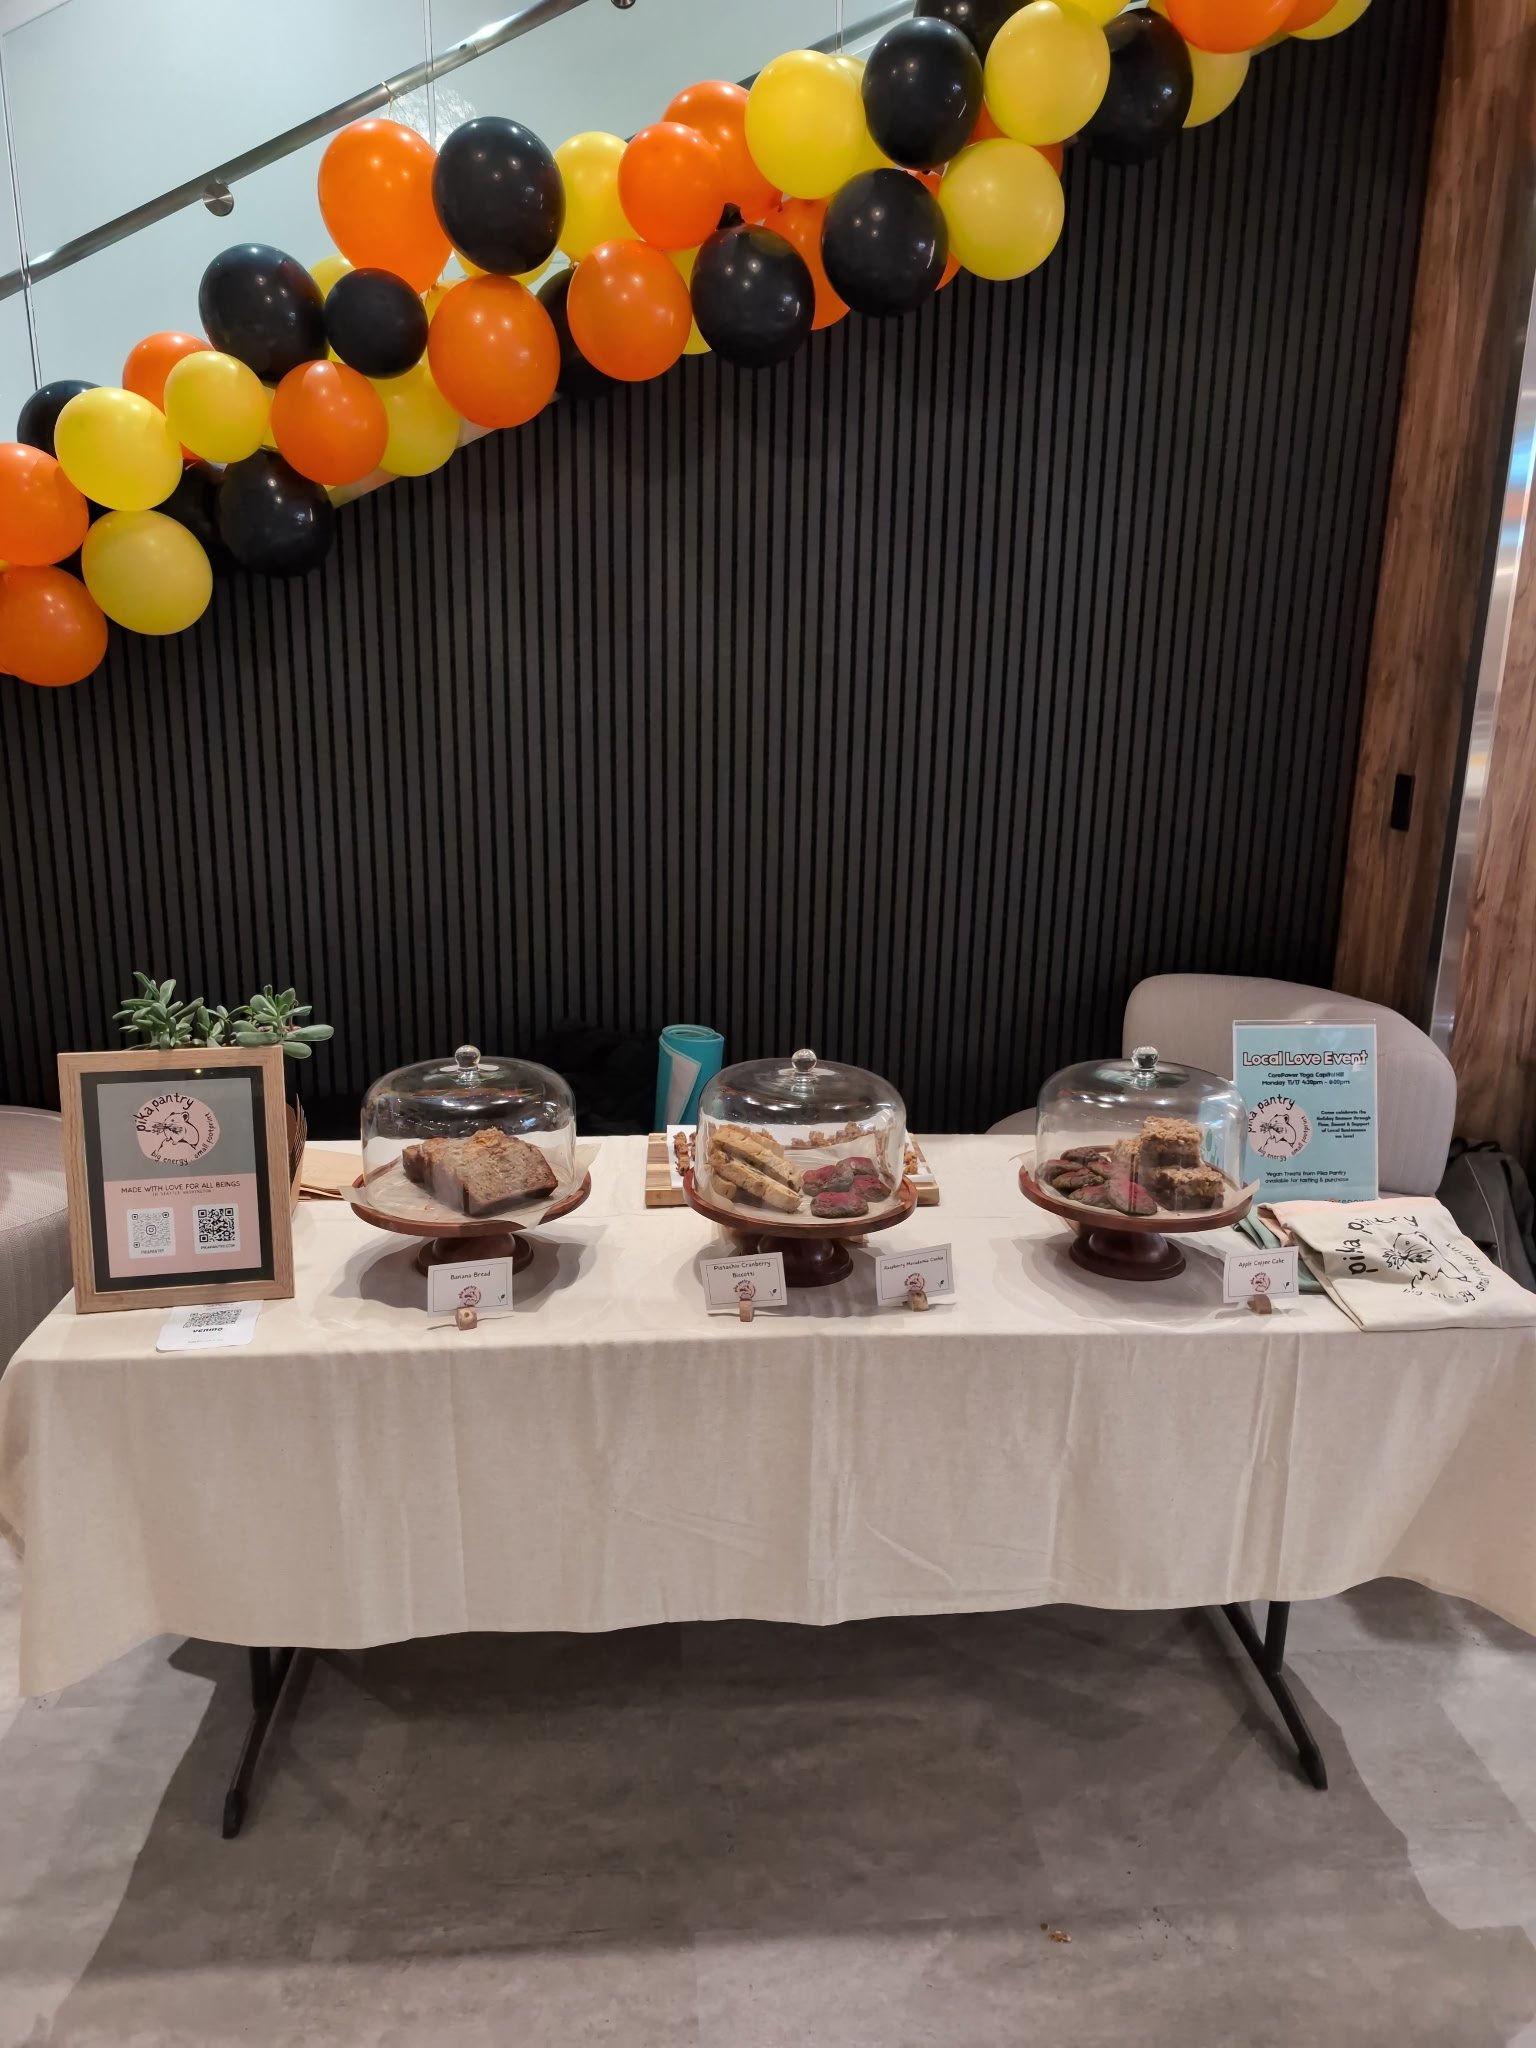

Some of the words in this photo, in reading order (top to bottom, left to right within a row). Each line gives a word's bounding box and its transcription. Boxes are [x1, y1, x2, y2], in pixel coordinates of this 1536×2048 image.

[1243, 1051, 1283, 1066] Local
[1285, 1052, 1321, 1066] Love
[1323, 1050, 1368, 1066] Event
[133, 1106, 153, 1132] pika
[152, 1093, 194, 1112] pantry
[1258, 1094, 1295, 1114] pantry
[151, 1150, 161, 1162] big
[164, 1157, 188, 1166] energy
